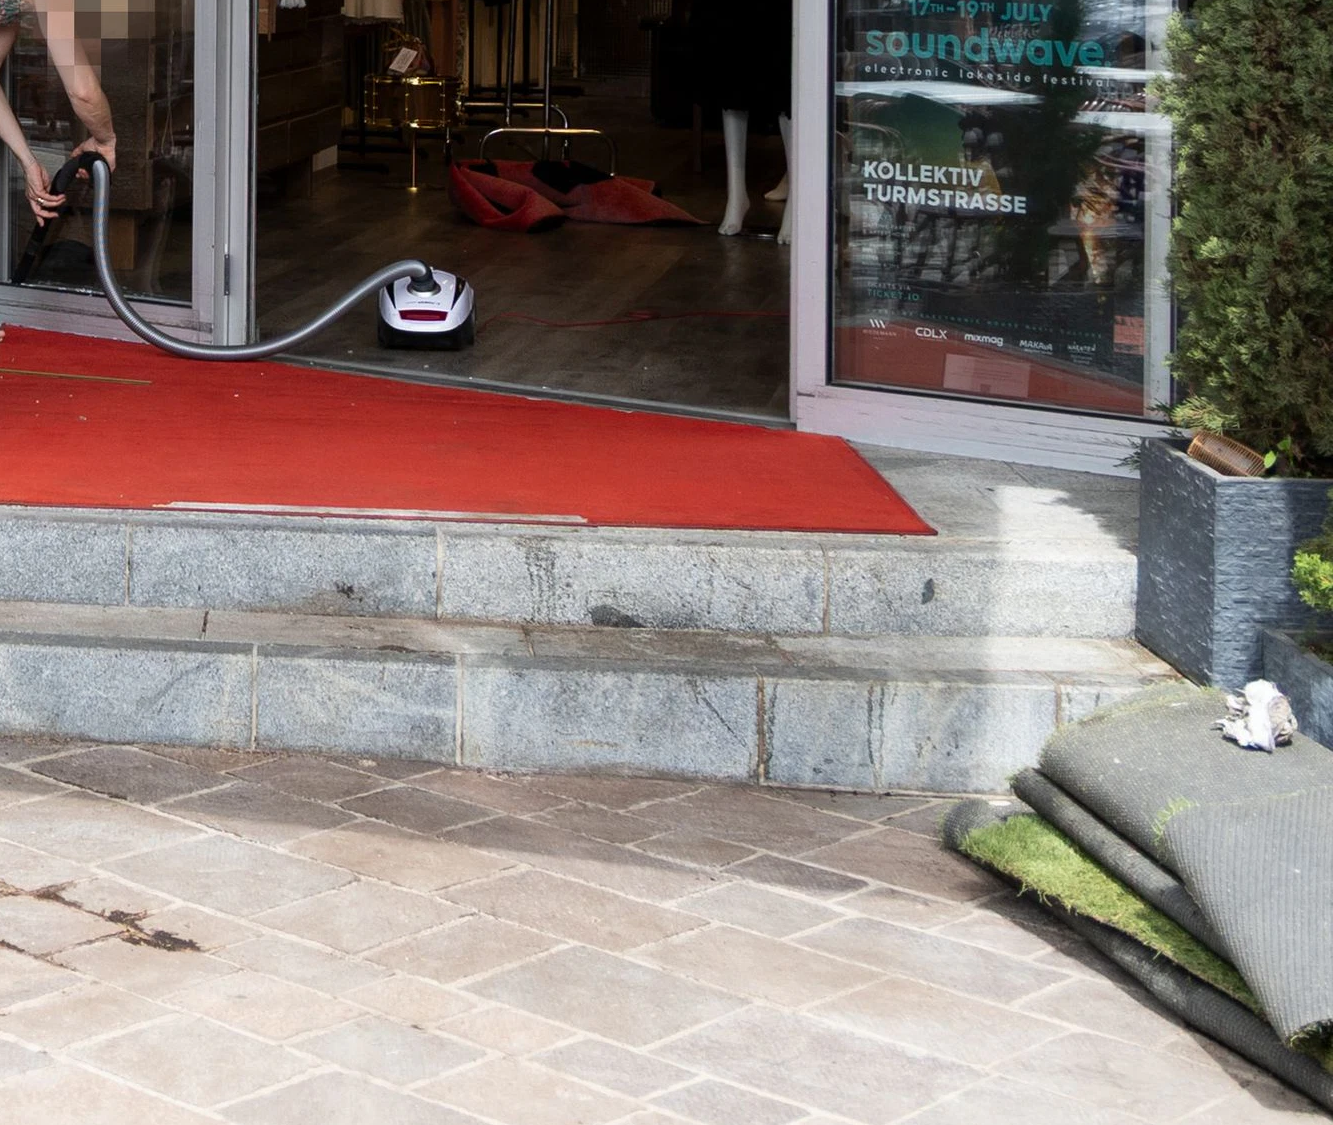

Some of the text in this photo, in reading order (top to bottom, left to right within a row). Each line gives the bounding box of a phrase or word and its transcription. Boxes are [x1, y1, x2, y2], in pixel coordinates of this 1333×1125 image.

[1000, 2, 1053, 22] JULY
[864, 64, 1111, 88] electronic lakeside festival
[863, 160, 983, 187] KOLLEKTIV
[863, 183, 1027, 215] TURMSTRASSE
[915, 327, 949, 340] CDLX
[964, 332, 1004, 347] mixmag
